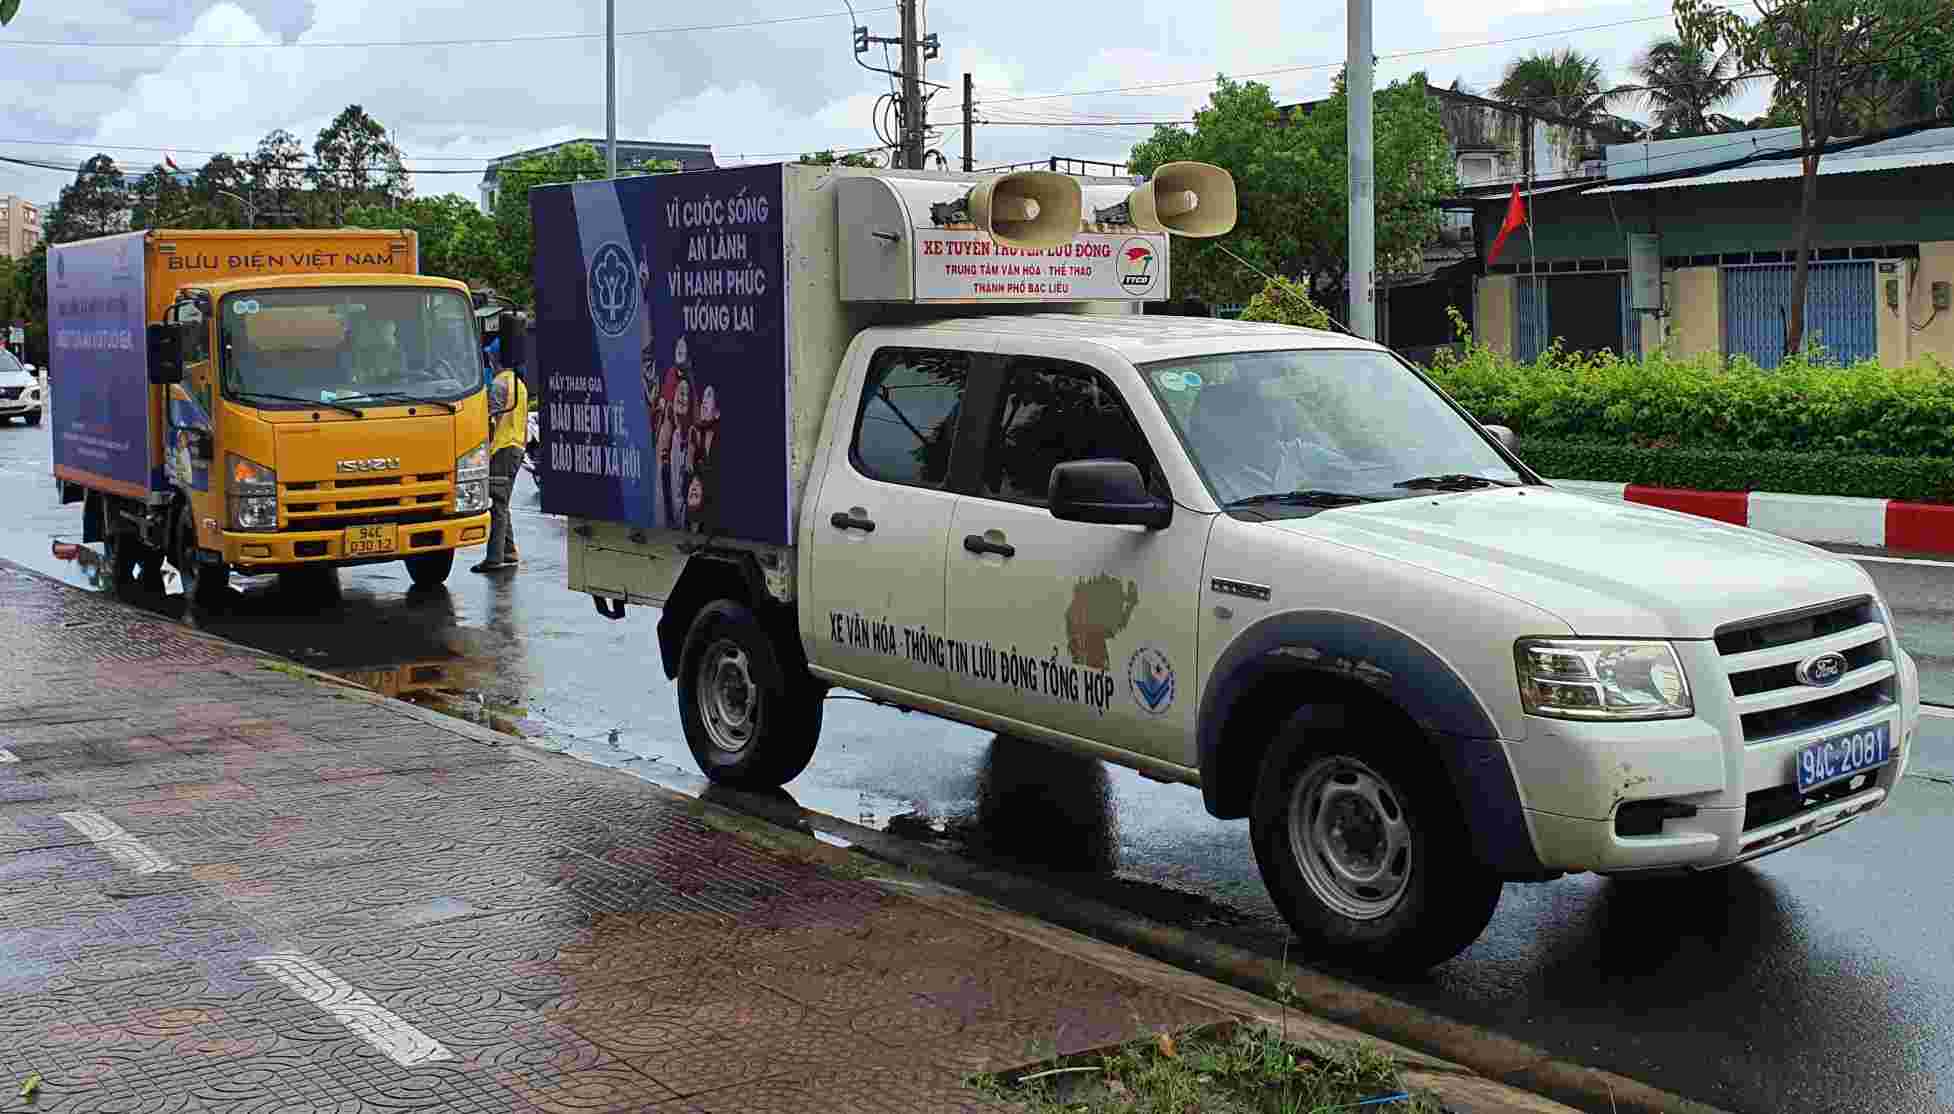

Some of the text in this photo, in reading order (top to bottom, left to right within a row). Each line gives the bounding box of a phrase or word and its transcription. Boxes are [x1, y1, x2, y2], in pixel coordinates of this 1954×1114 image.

[665, 185, 769, 233] VÌ CUỘC SỐNG
[168, 249, 393, 271] BƯU ĐIỆN VIỆT NAM
[687, 228, 748, 261] AN LÀNH
[923, 240, 943, 255] XE
[727, 261, 767, 296] PHÚC
[945, 264, 977, 275] TRUNG
[980, 262, 999, 275] TÂM
[1070, 266, 1092, 276] THAO
[682, 300, 754, 332] TƯƠNG LAI
[550, 393, 572, 432] BẢO
[573, 392, 600, 433] HIỂM
[336, 457, 400, 473] ISUZU
[551, 432, 573, 472] BẢO
[574, 431, 602, 474] HIỂM
[830, 610, 844, 643] XE
[872, 615, 896, 655] HÓA
[904, 624, 945, 668] THÔNG
[947, 639, 968, 676] TIN
[971, 641, 996, 681] LƯU
[1000, 645, 1037, 695] ĐỘNG
[1040, 645, 1079, 701] TỔNG
[1084, 668, 1114, 717] HỢP
